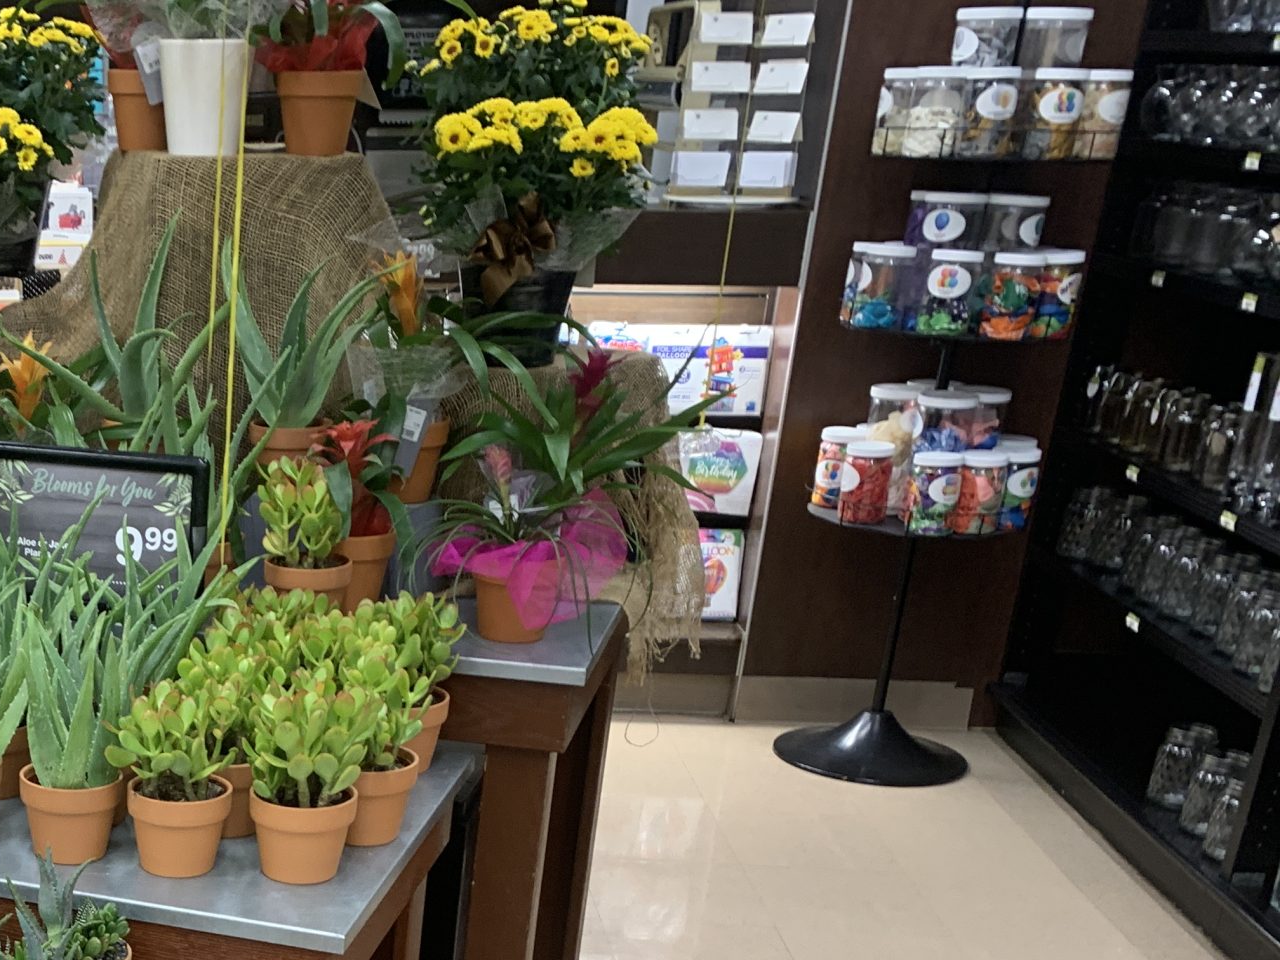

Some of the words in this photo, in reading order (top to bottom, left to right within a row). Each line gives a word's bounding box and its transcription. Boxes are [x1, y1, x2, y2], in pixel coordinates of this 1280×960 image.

[696, 460, 738, 480] Birthday
[31, 468, 92, 497] Blooms
[94, 474, 116, 508] for
[121, 476, 157, 507] You
